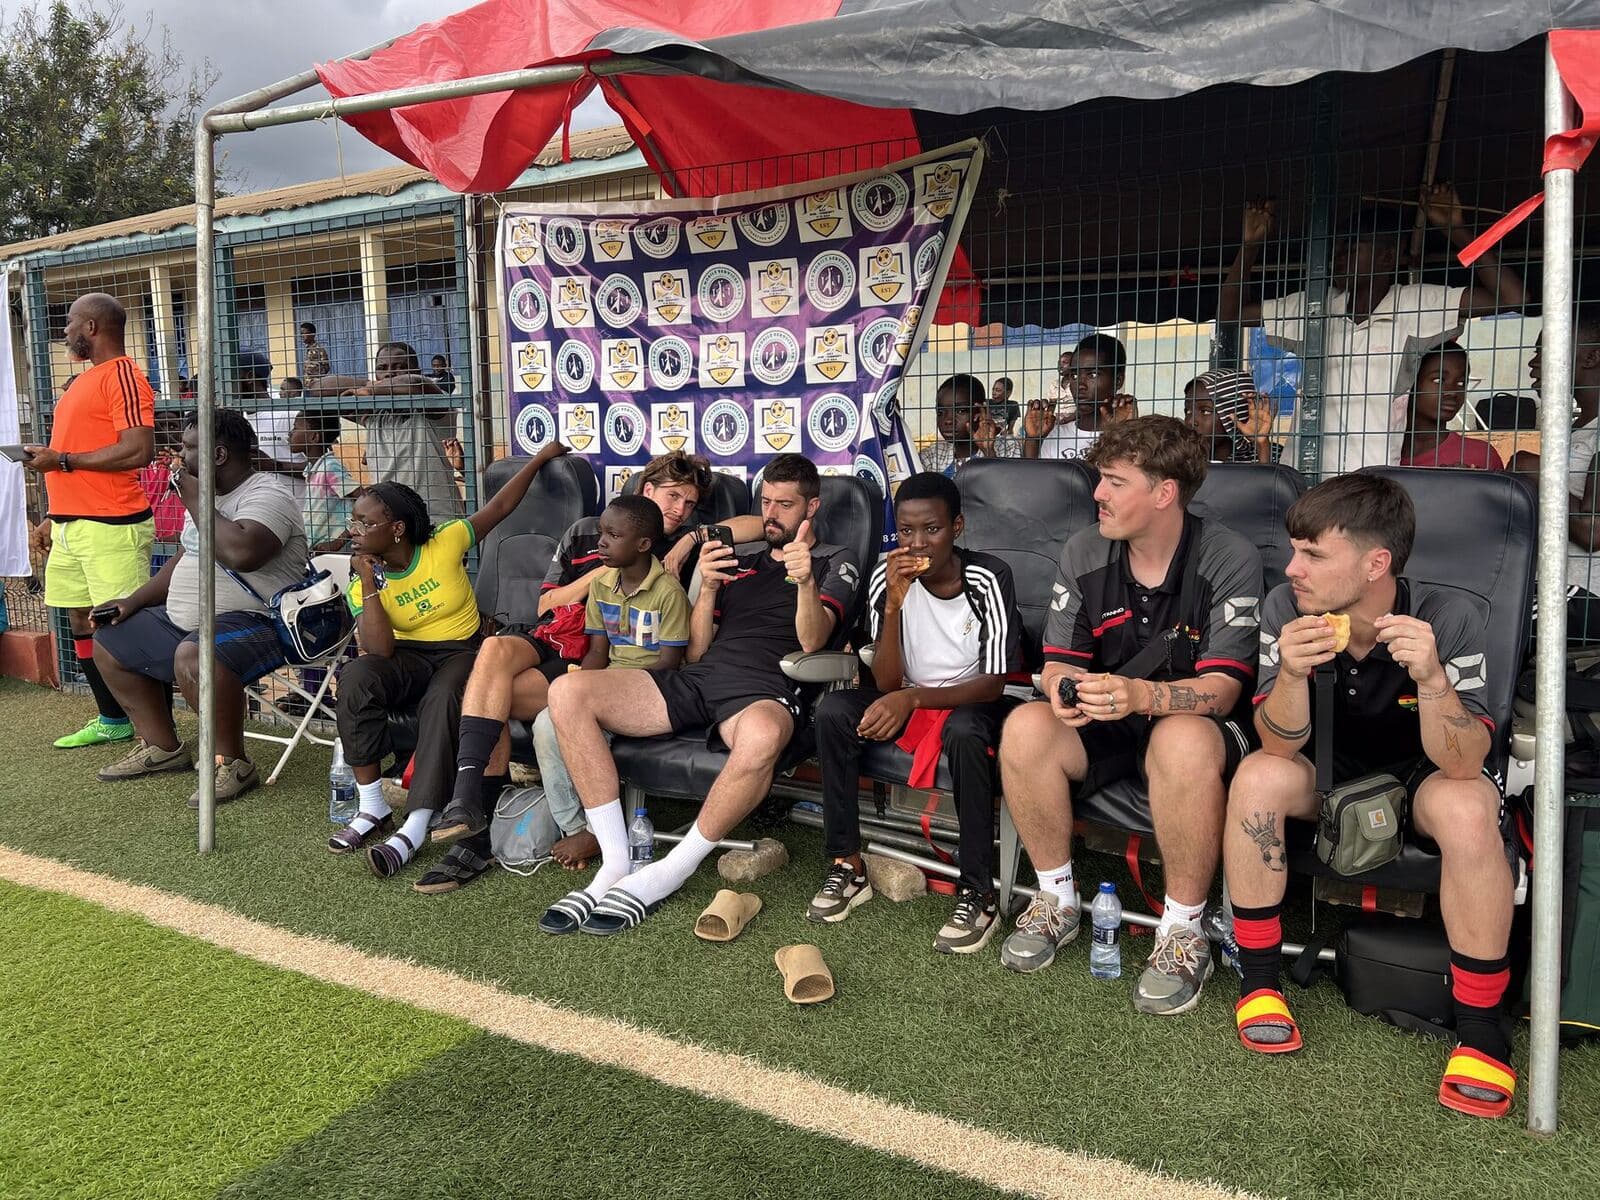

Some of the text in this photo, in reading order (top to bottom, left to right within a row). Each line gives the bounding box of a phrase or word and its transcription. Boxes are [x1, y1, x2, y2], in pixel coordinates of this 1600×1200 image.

[394, 577, 441, 607] BRASIL
[636, 610, 659, 647] H
[1054, 874, 1073, 885] FIL
